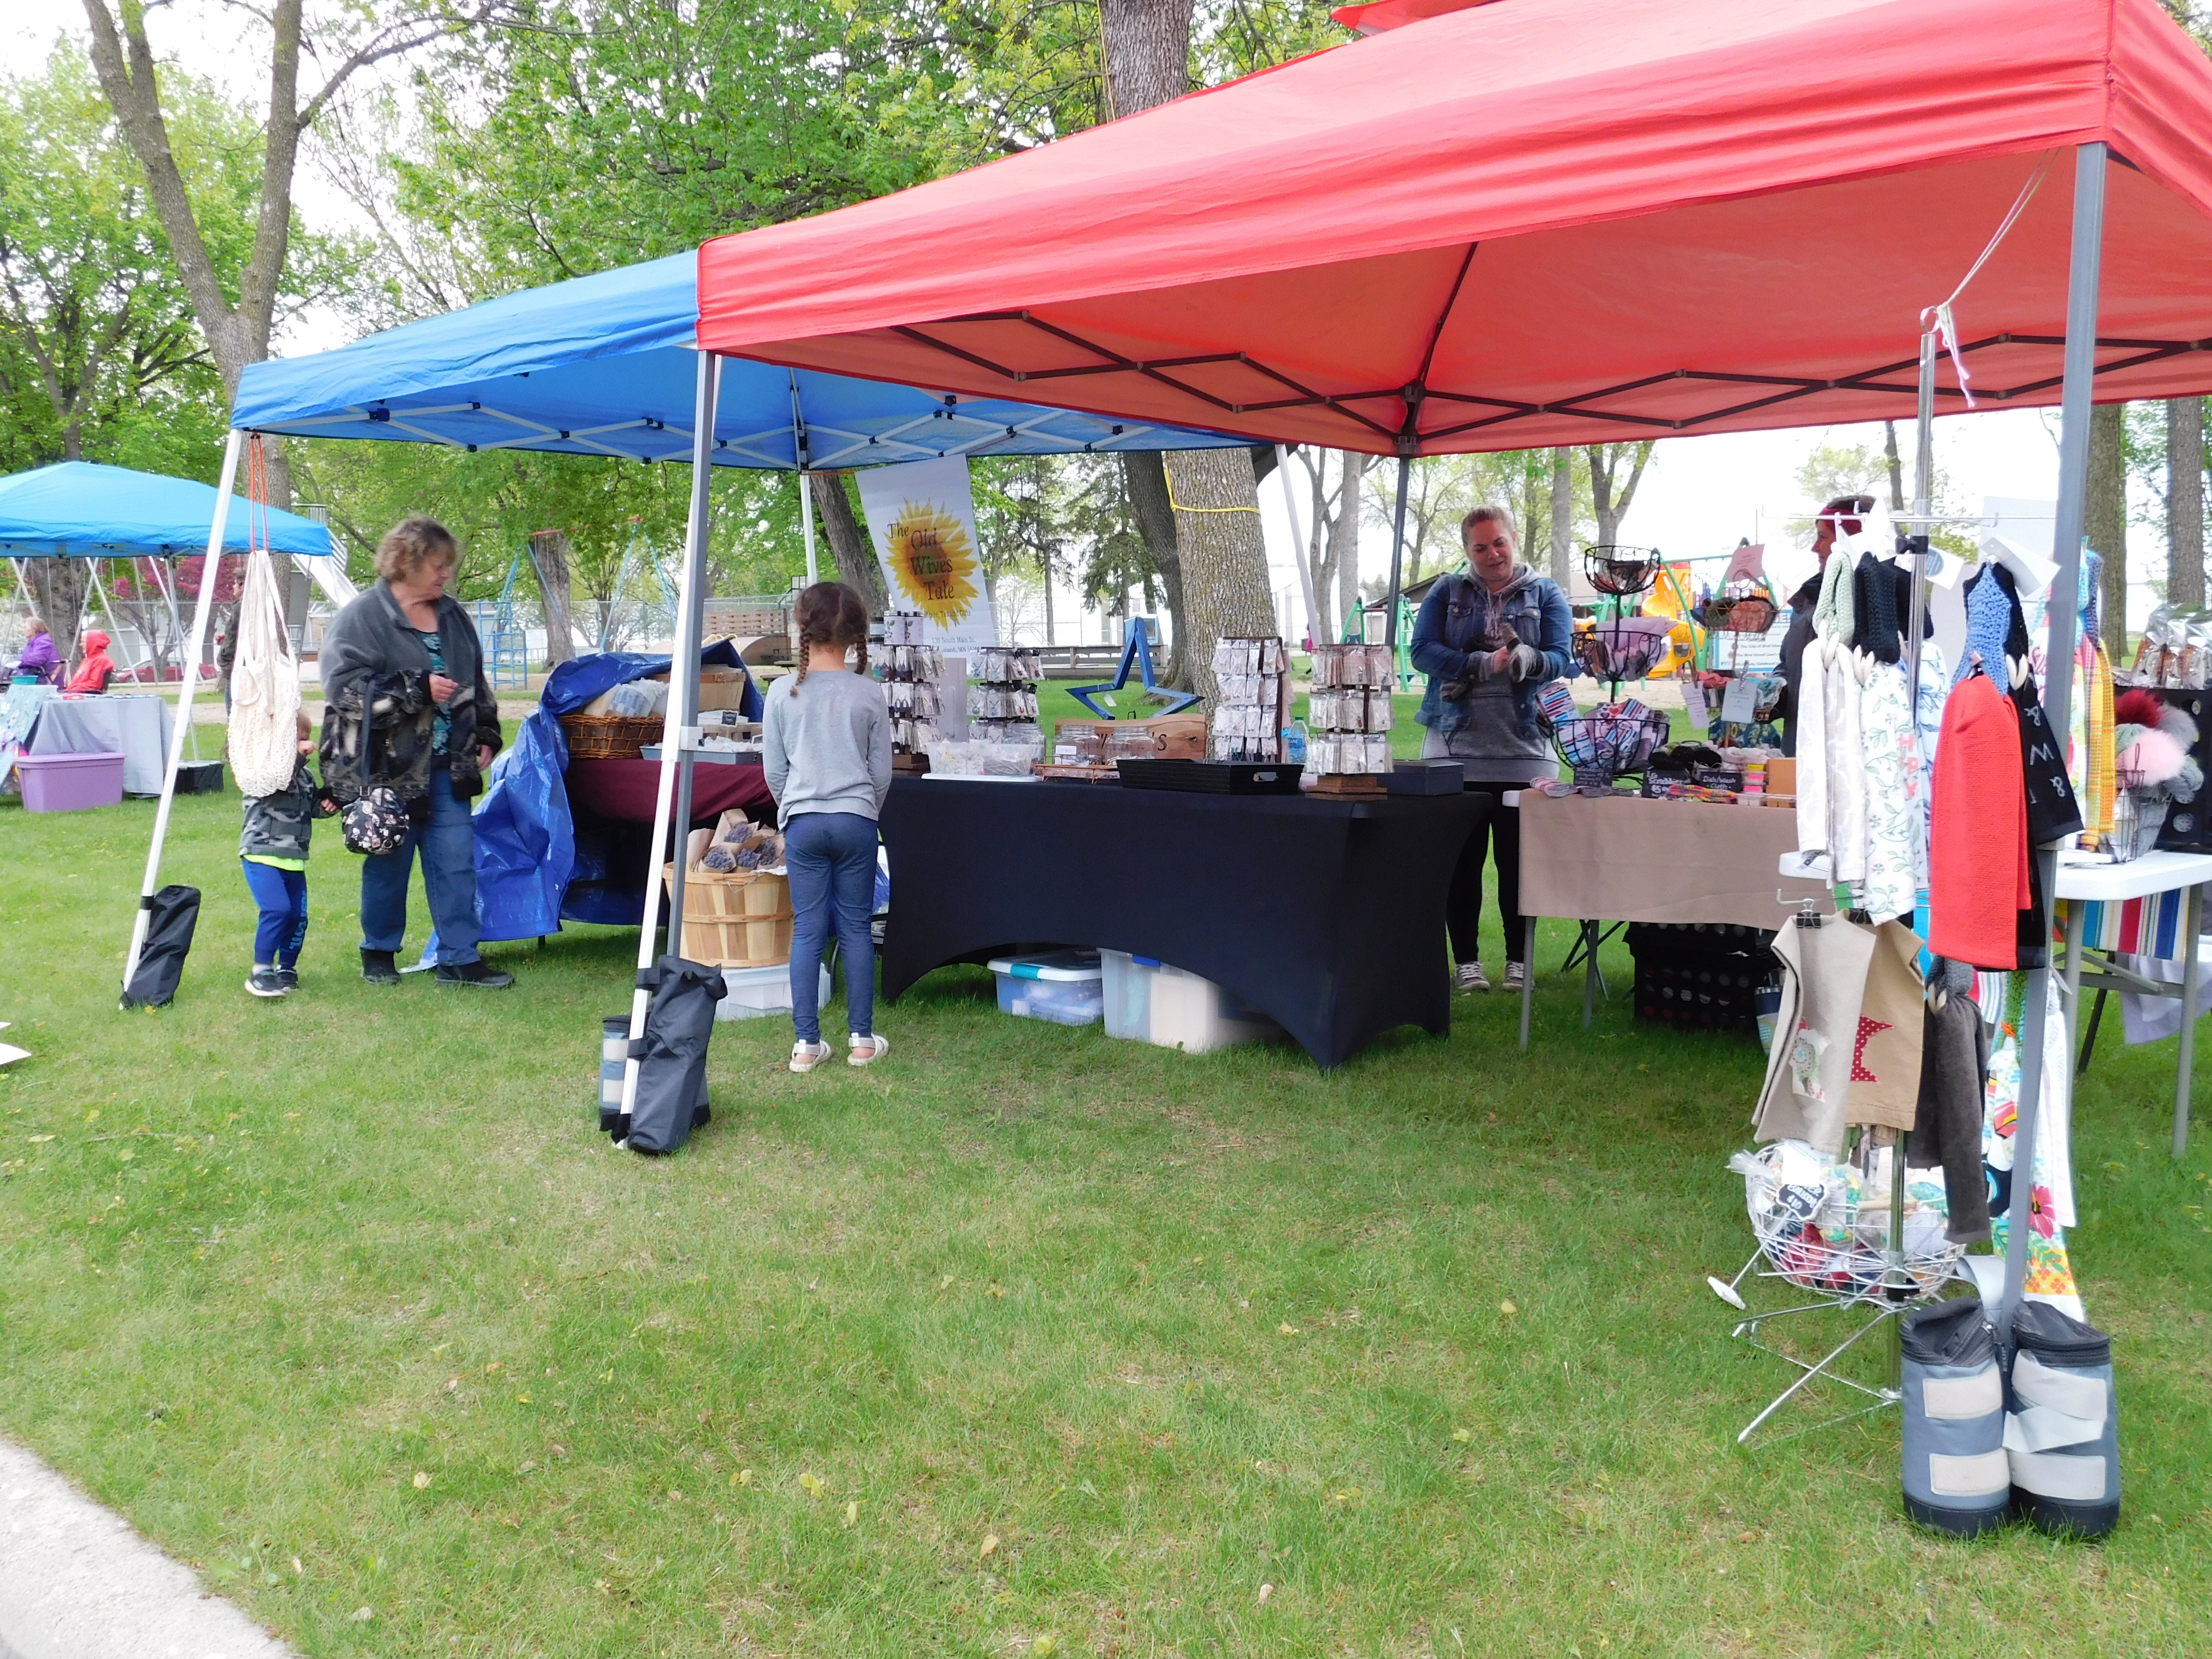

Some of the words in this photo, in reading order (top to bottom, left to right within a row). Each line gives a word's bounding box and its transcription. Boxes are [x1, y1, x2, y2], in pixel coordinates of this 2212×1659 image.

[887, 522, 909, 539] The
[911, 528, 938, 551] Old
[910, 555, 953, 576] Wives
[923, 579, 954, 600] Tale
